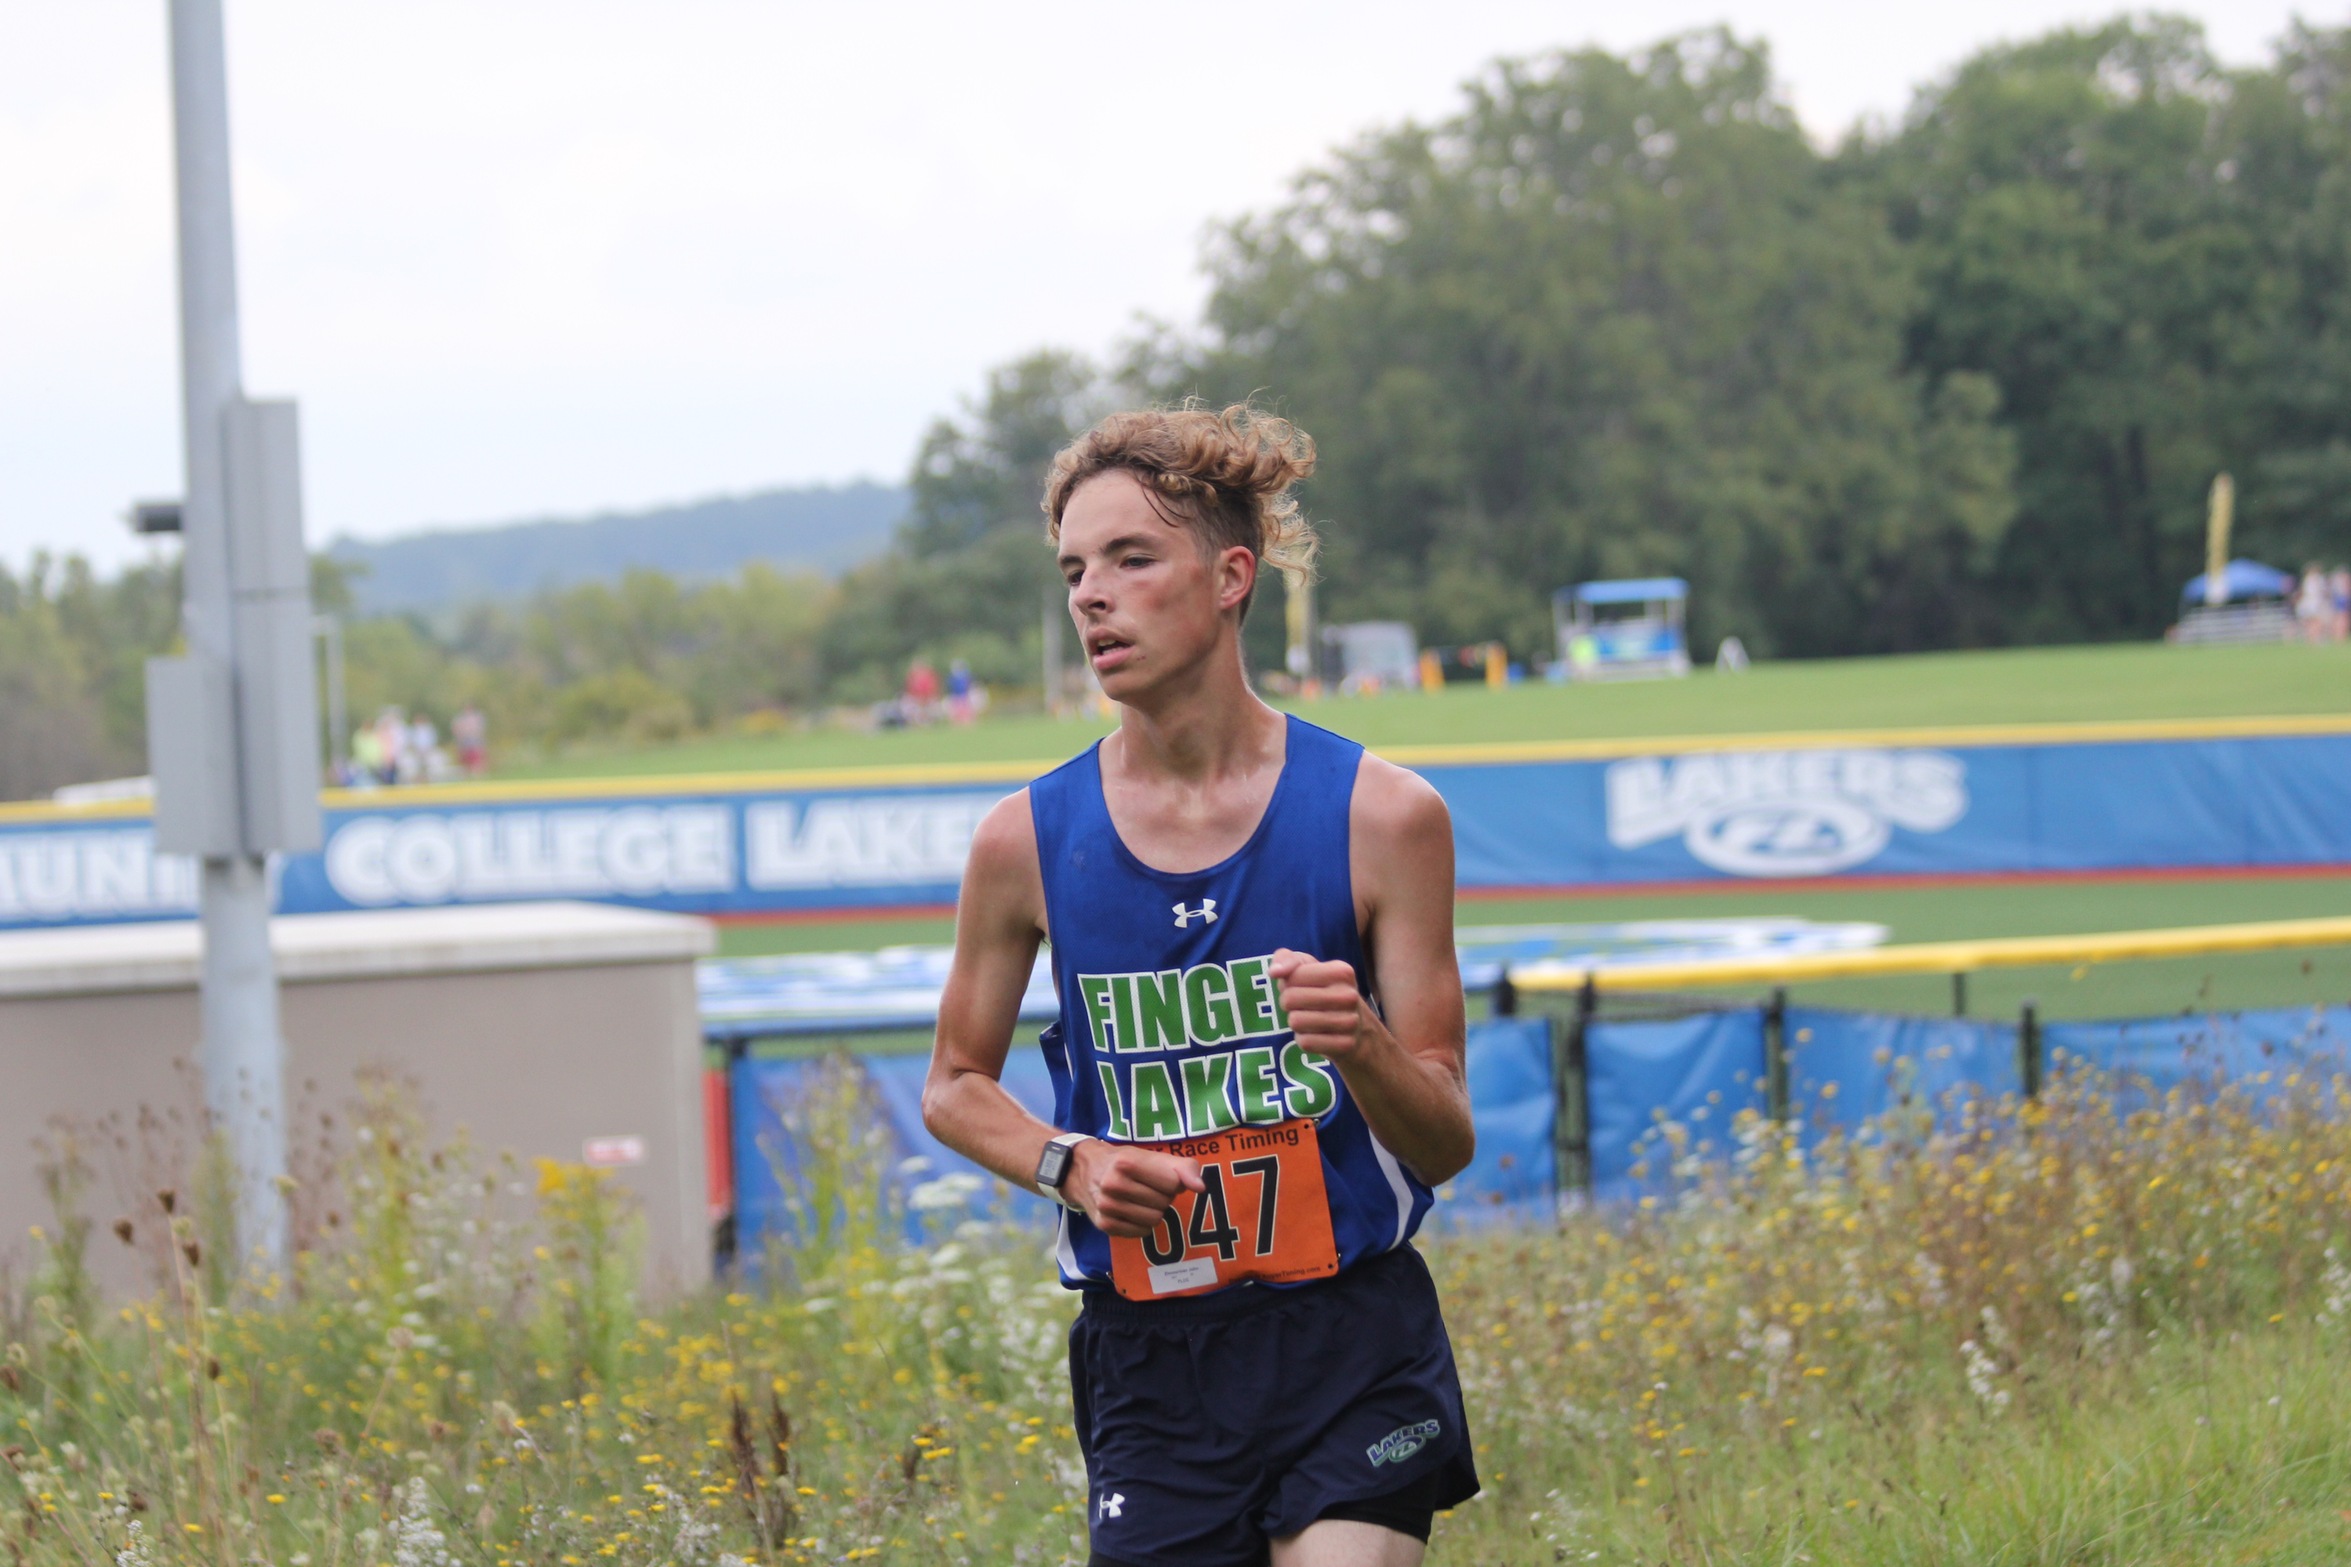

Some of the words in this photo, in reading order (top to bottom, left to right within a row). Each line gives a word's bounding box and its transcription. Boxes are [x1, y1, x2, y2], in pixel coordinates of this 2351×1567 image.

[325, 802, 734, 907] COLLEGE
[746, 792, 1000, 891] LAKE
[1605, 748, 1969, 850] LAKERS
[1096, 1041, 1336, 1142] LAKES
[1169, 1140, 1220, 1158] Race
[1225, 1128, 1299, 1151] Timing
[1366, 1418, 1441, 1468] LAKERS
